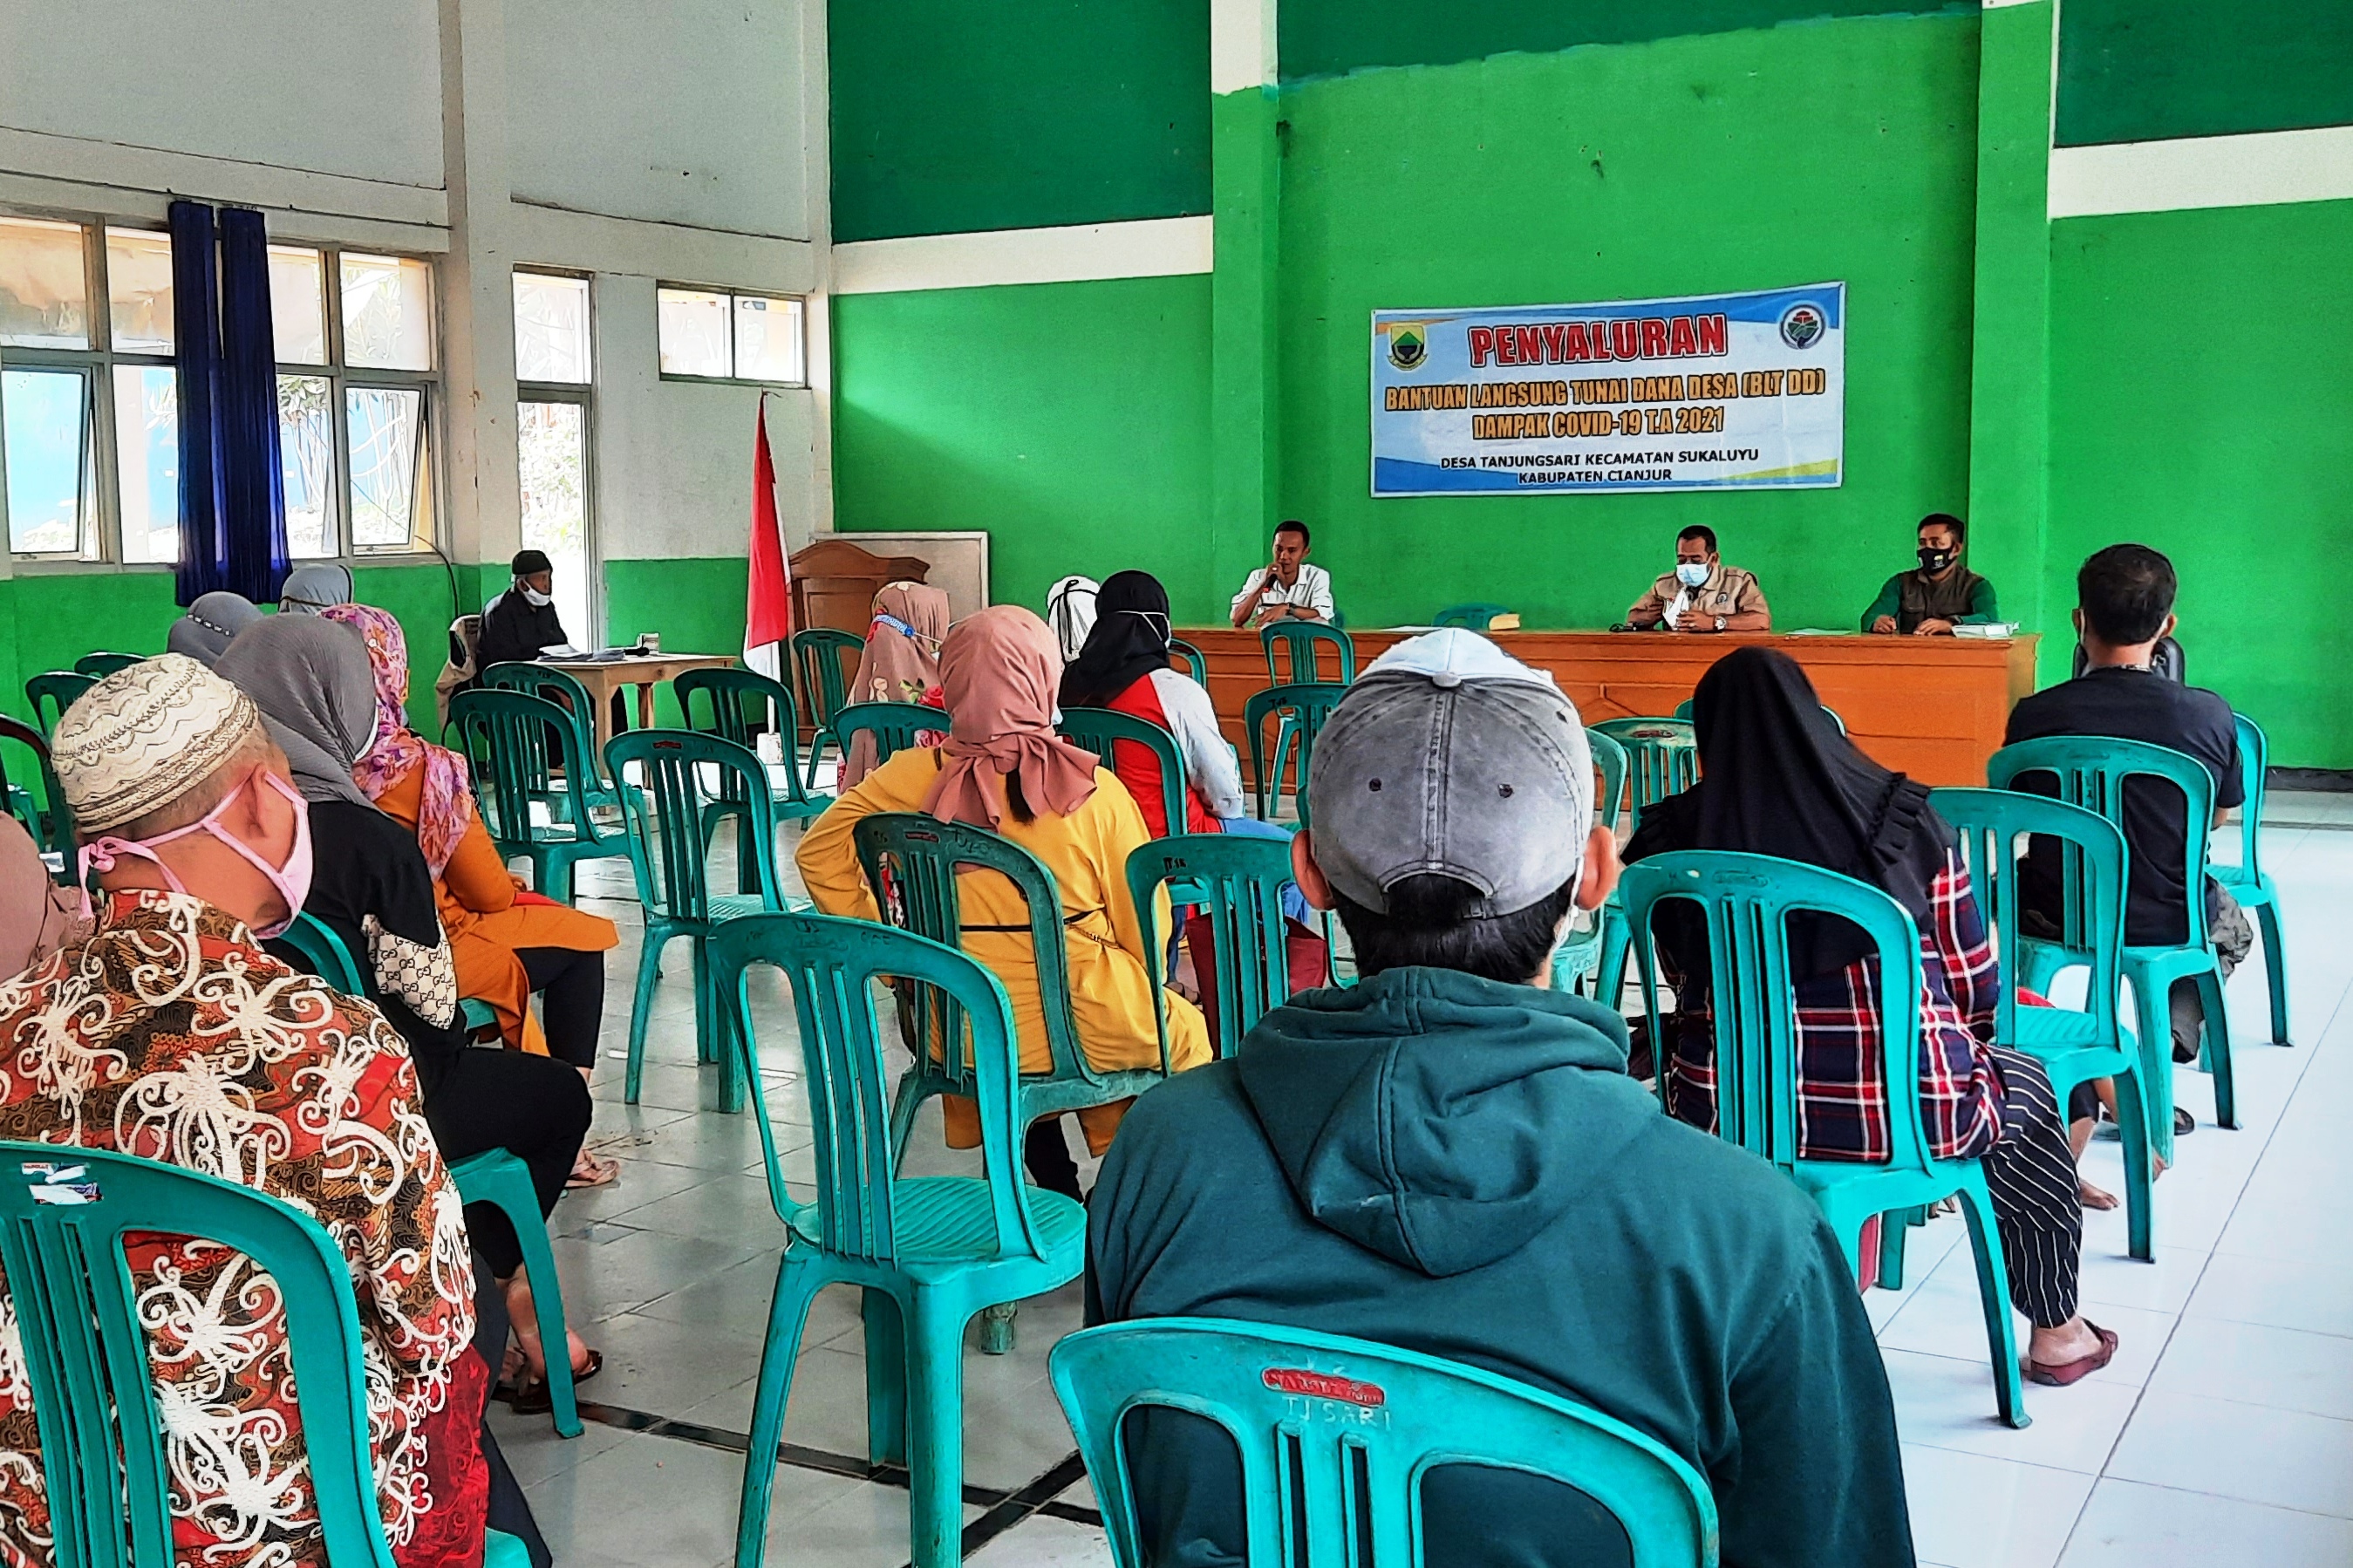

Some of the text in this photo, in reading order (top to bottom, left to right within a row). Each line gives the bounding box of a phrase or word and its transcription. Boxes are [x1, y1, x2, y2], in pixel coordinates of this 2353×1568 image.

[1468, 313, 1728, 367] PENYALURAN
[1385, 368, 1825, 412] BANTUAN LANGSUNG TUNAI DANA DESA (BLT DD)
[1472, 406, 1724, 440] DAMPAK COVID-19 T.A 2021
[1441, 449, 1759, 468] DESA TANJUNGSARI KECAMATAN SUKALUYU
[1518, 469, 1672, 484] KABUPATEN CIANJUR
